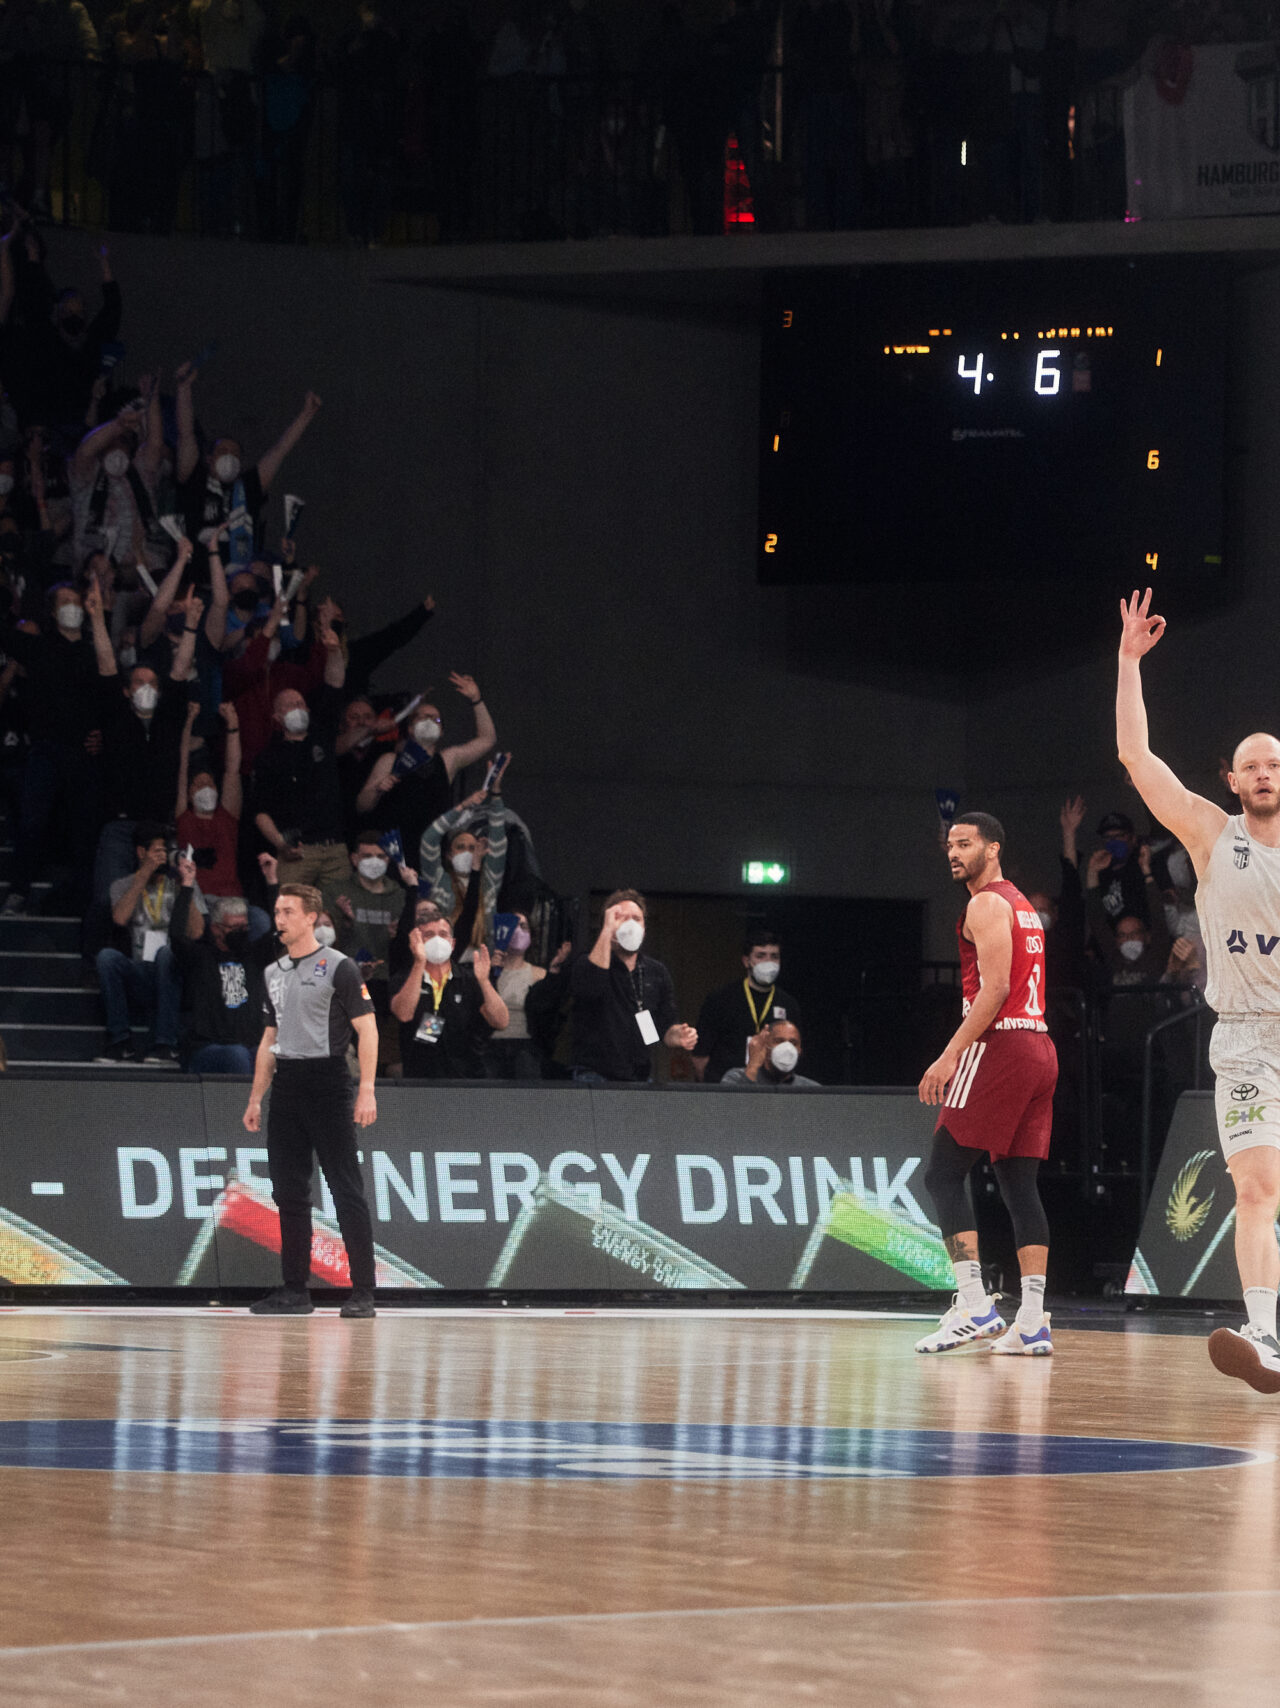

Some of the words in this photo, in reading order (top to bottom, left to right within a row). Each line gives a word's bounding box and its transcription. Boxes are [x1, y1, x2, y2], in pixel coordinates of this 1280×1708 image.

[1198, 161, 1280, 186] HAMBURG
[782, 310, 793, 328] 3
[1154, 348, 1162, 367] 1
[1034, 349, 1061, 396] 6
[773, 434, 780, 453] 1
[1146, 449, 1160, 470] 6
[764, 533, 778, 553] 2
[1145, 552, 1158, 570] 4
[675, 1154, 932, 1226] DRINK
